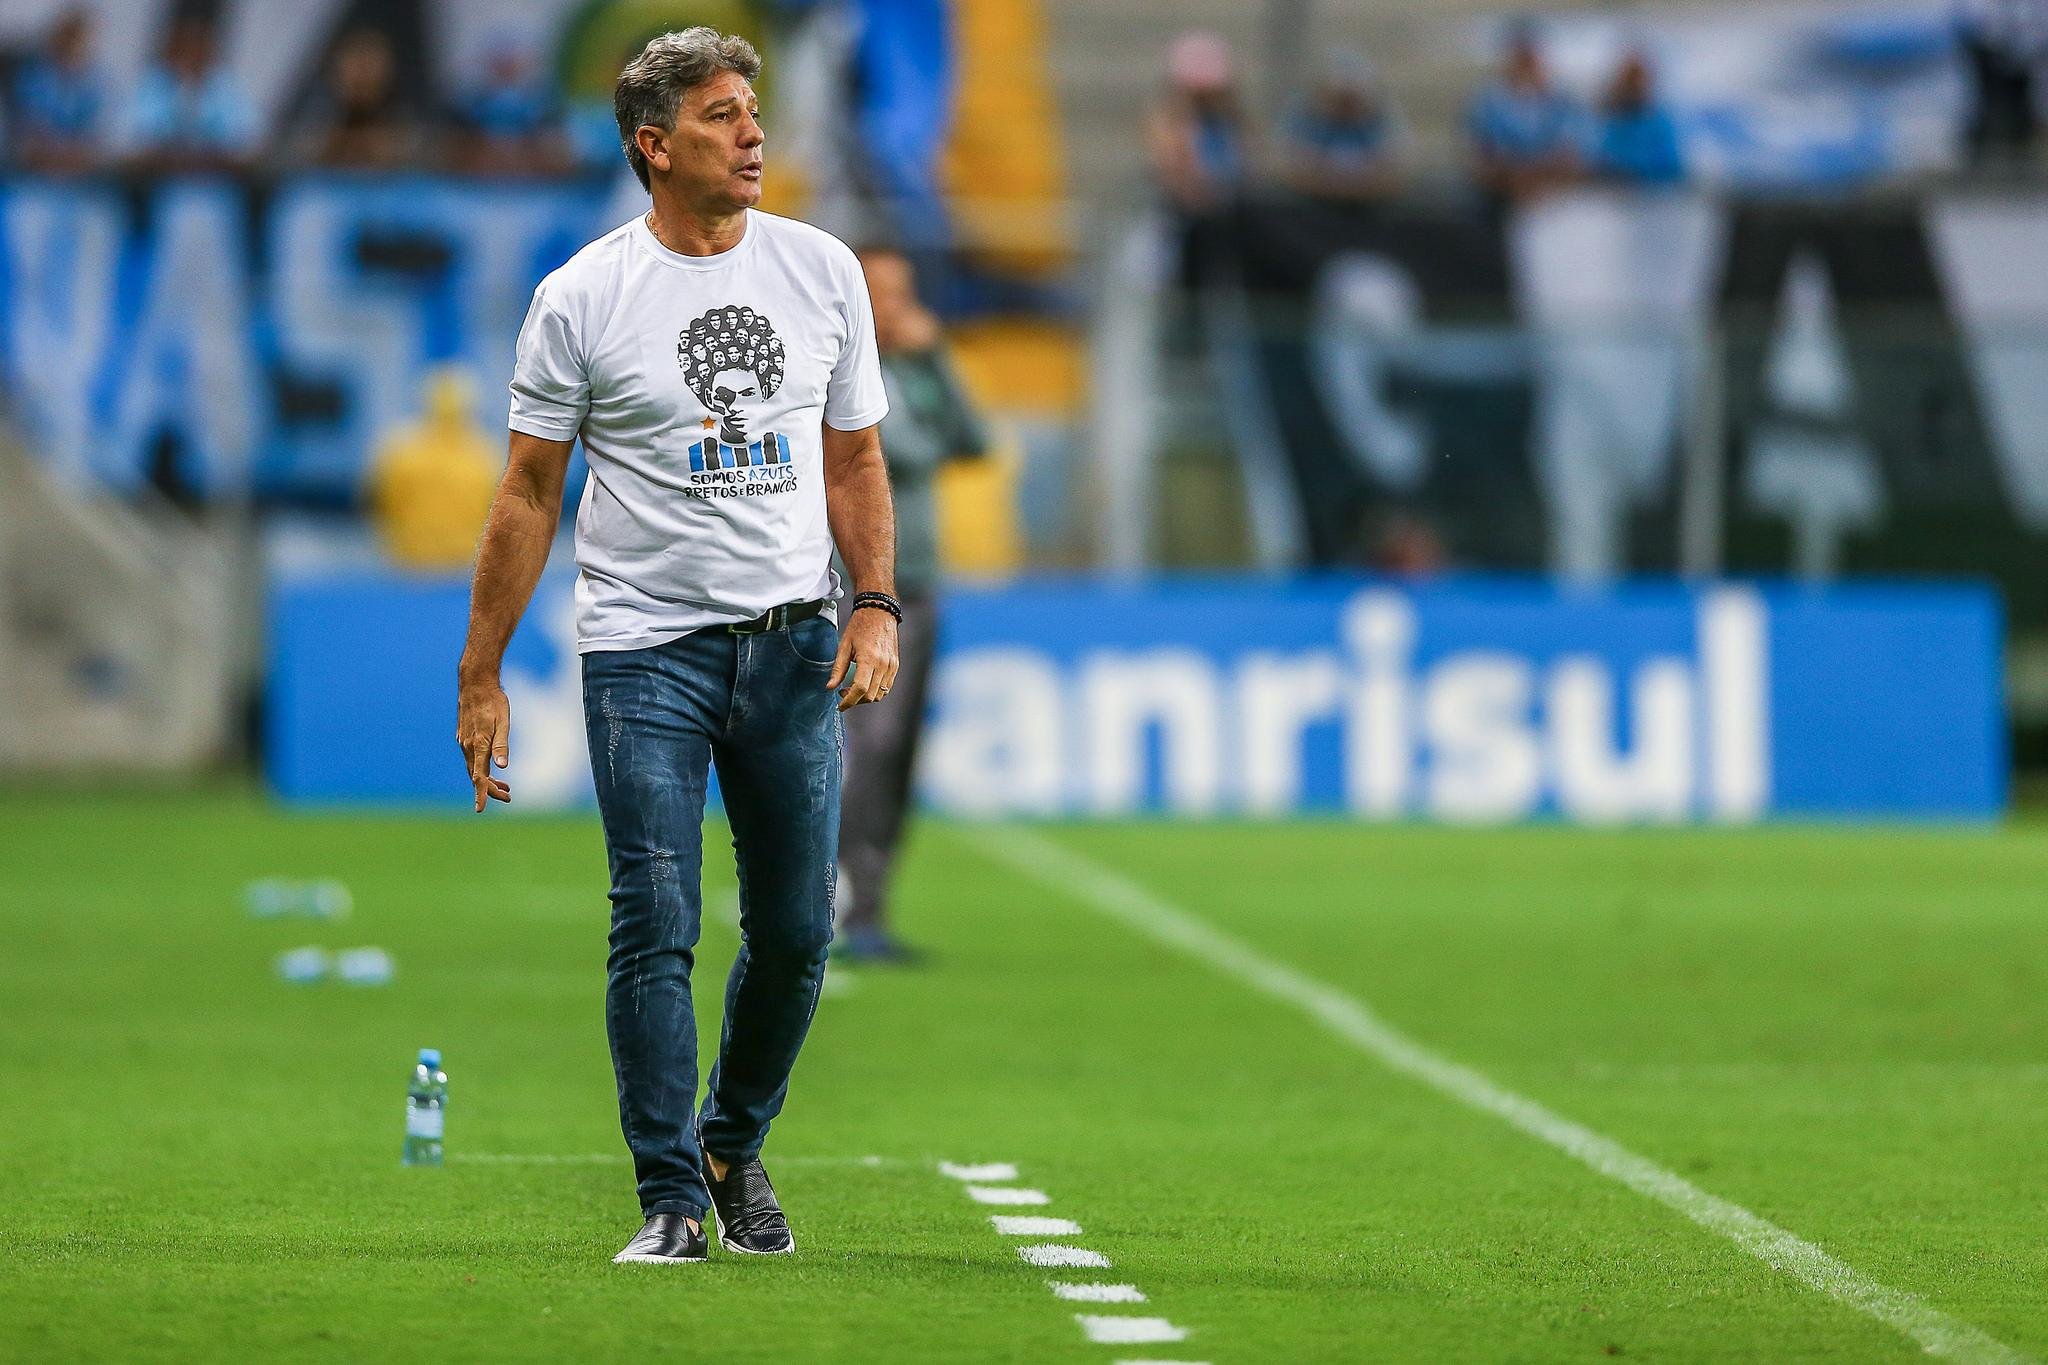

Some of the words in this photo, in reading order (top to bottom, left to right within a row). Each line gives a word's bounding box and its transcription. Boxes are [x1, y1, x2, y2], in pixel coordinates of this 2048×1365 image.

[690, 470, 746, 486] SOMOS
[748, 465, 794, 481] AZUIS
[684, 485, 738, 499] PRETOS
[746, 477, 797, 497] BRANCOS
[920, 587, 1771, 823] anrisul
